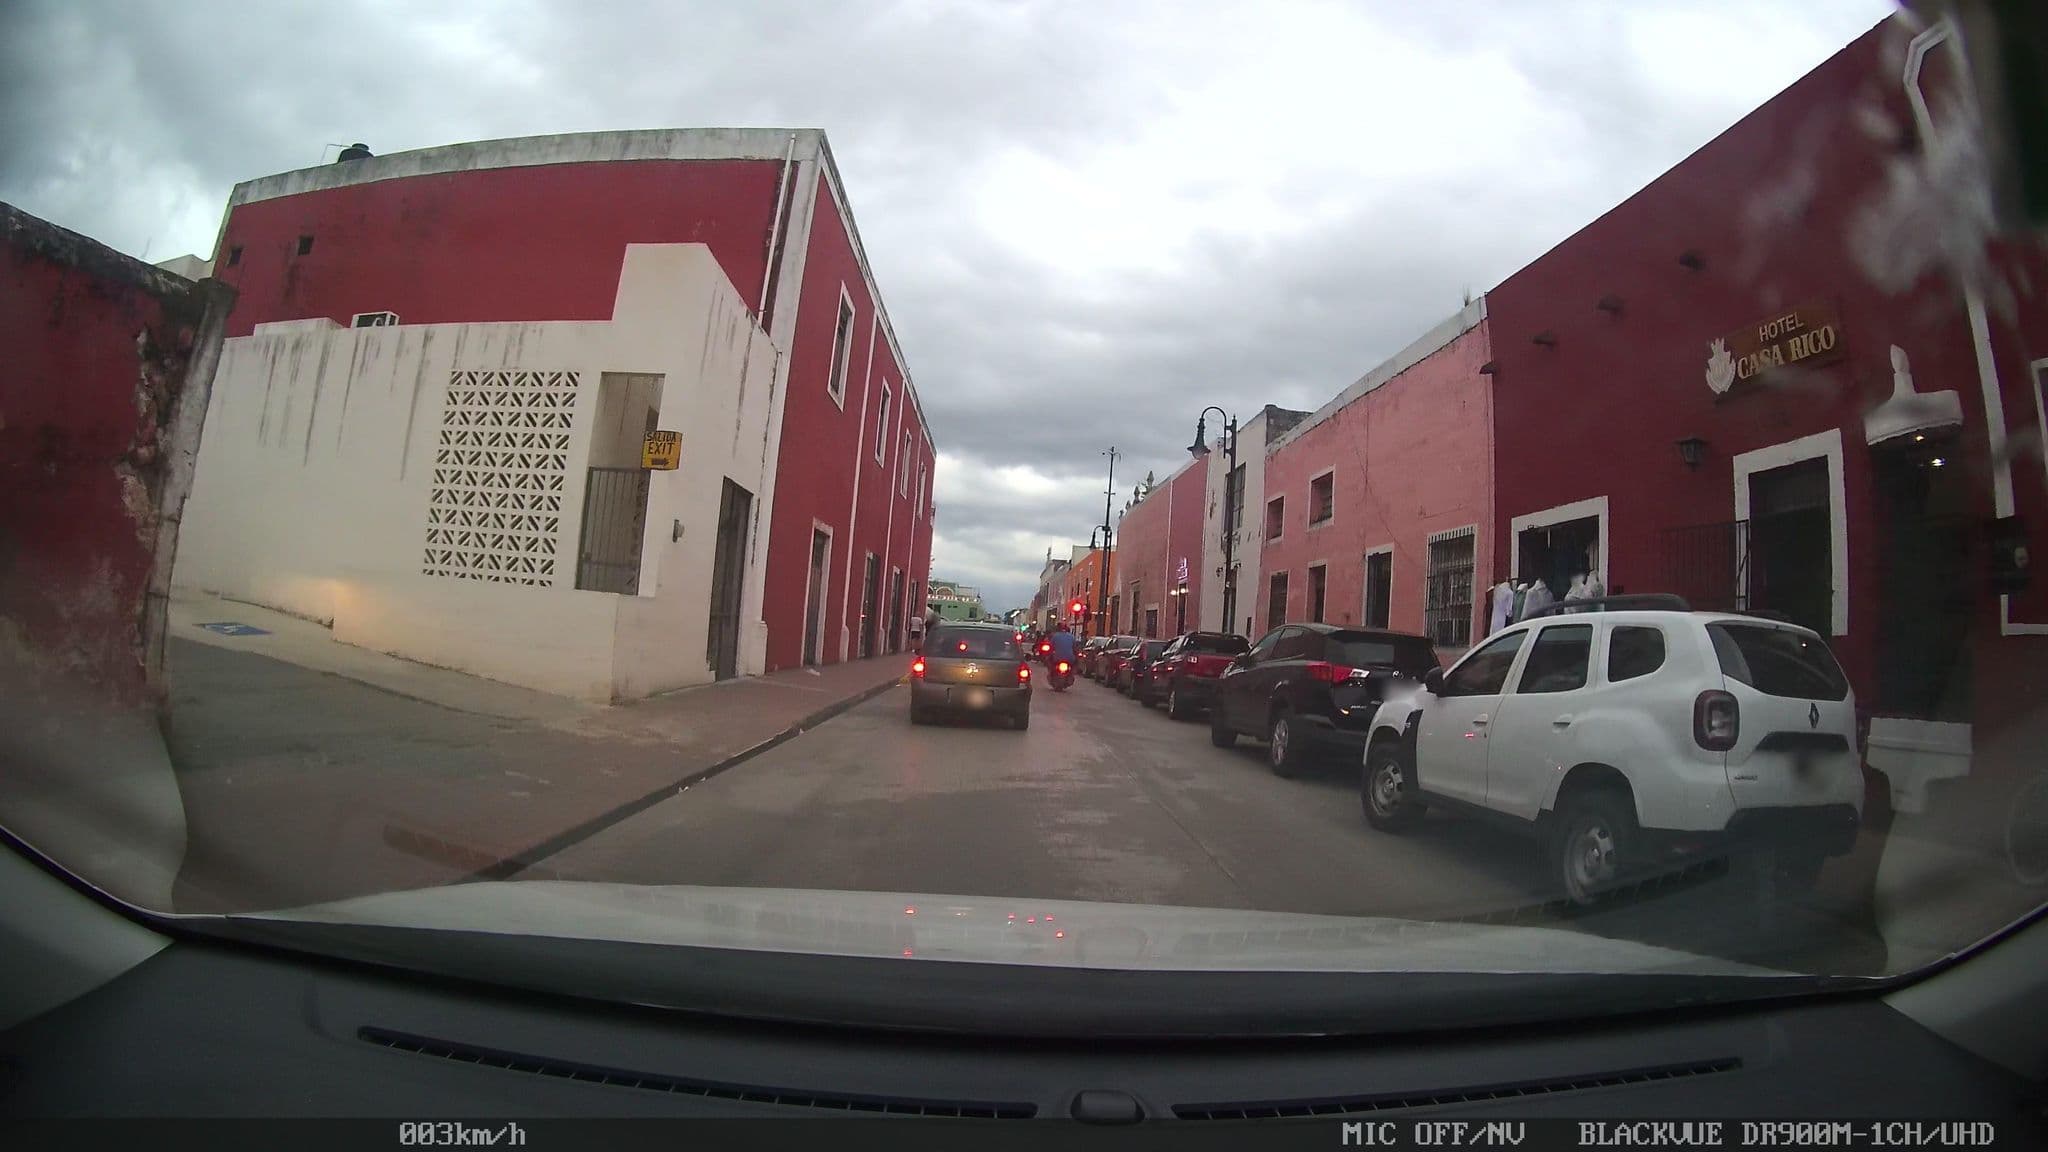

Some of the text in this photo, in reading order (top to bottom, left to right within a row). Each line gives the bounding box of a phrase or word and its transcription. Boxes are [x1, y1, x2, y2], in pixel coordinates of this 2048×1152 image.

[1759, 312, 1804, 342] HOTEL
[1737, 325, 1836, 380] CASA RICO
[646, 431, 677, 443] SALIDA
[647, 442, 675, 455] EXIT
